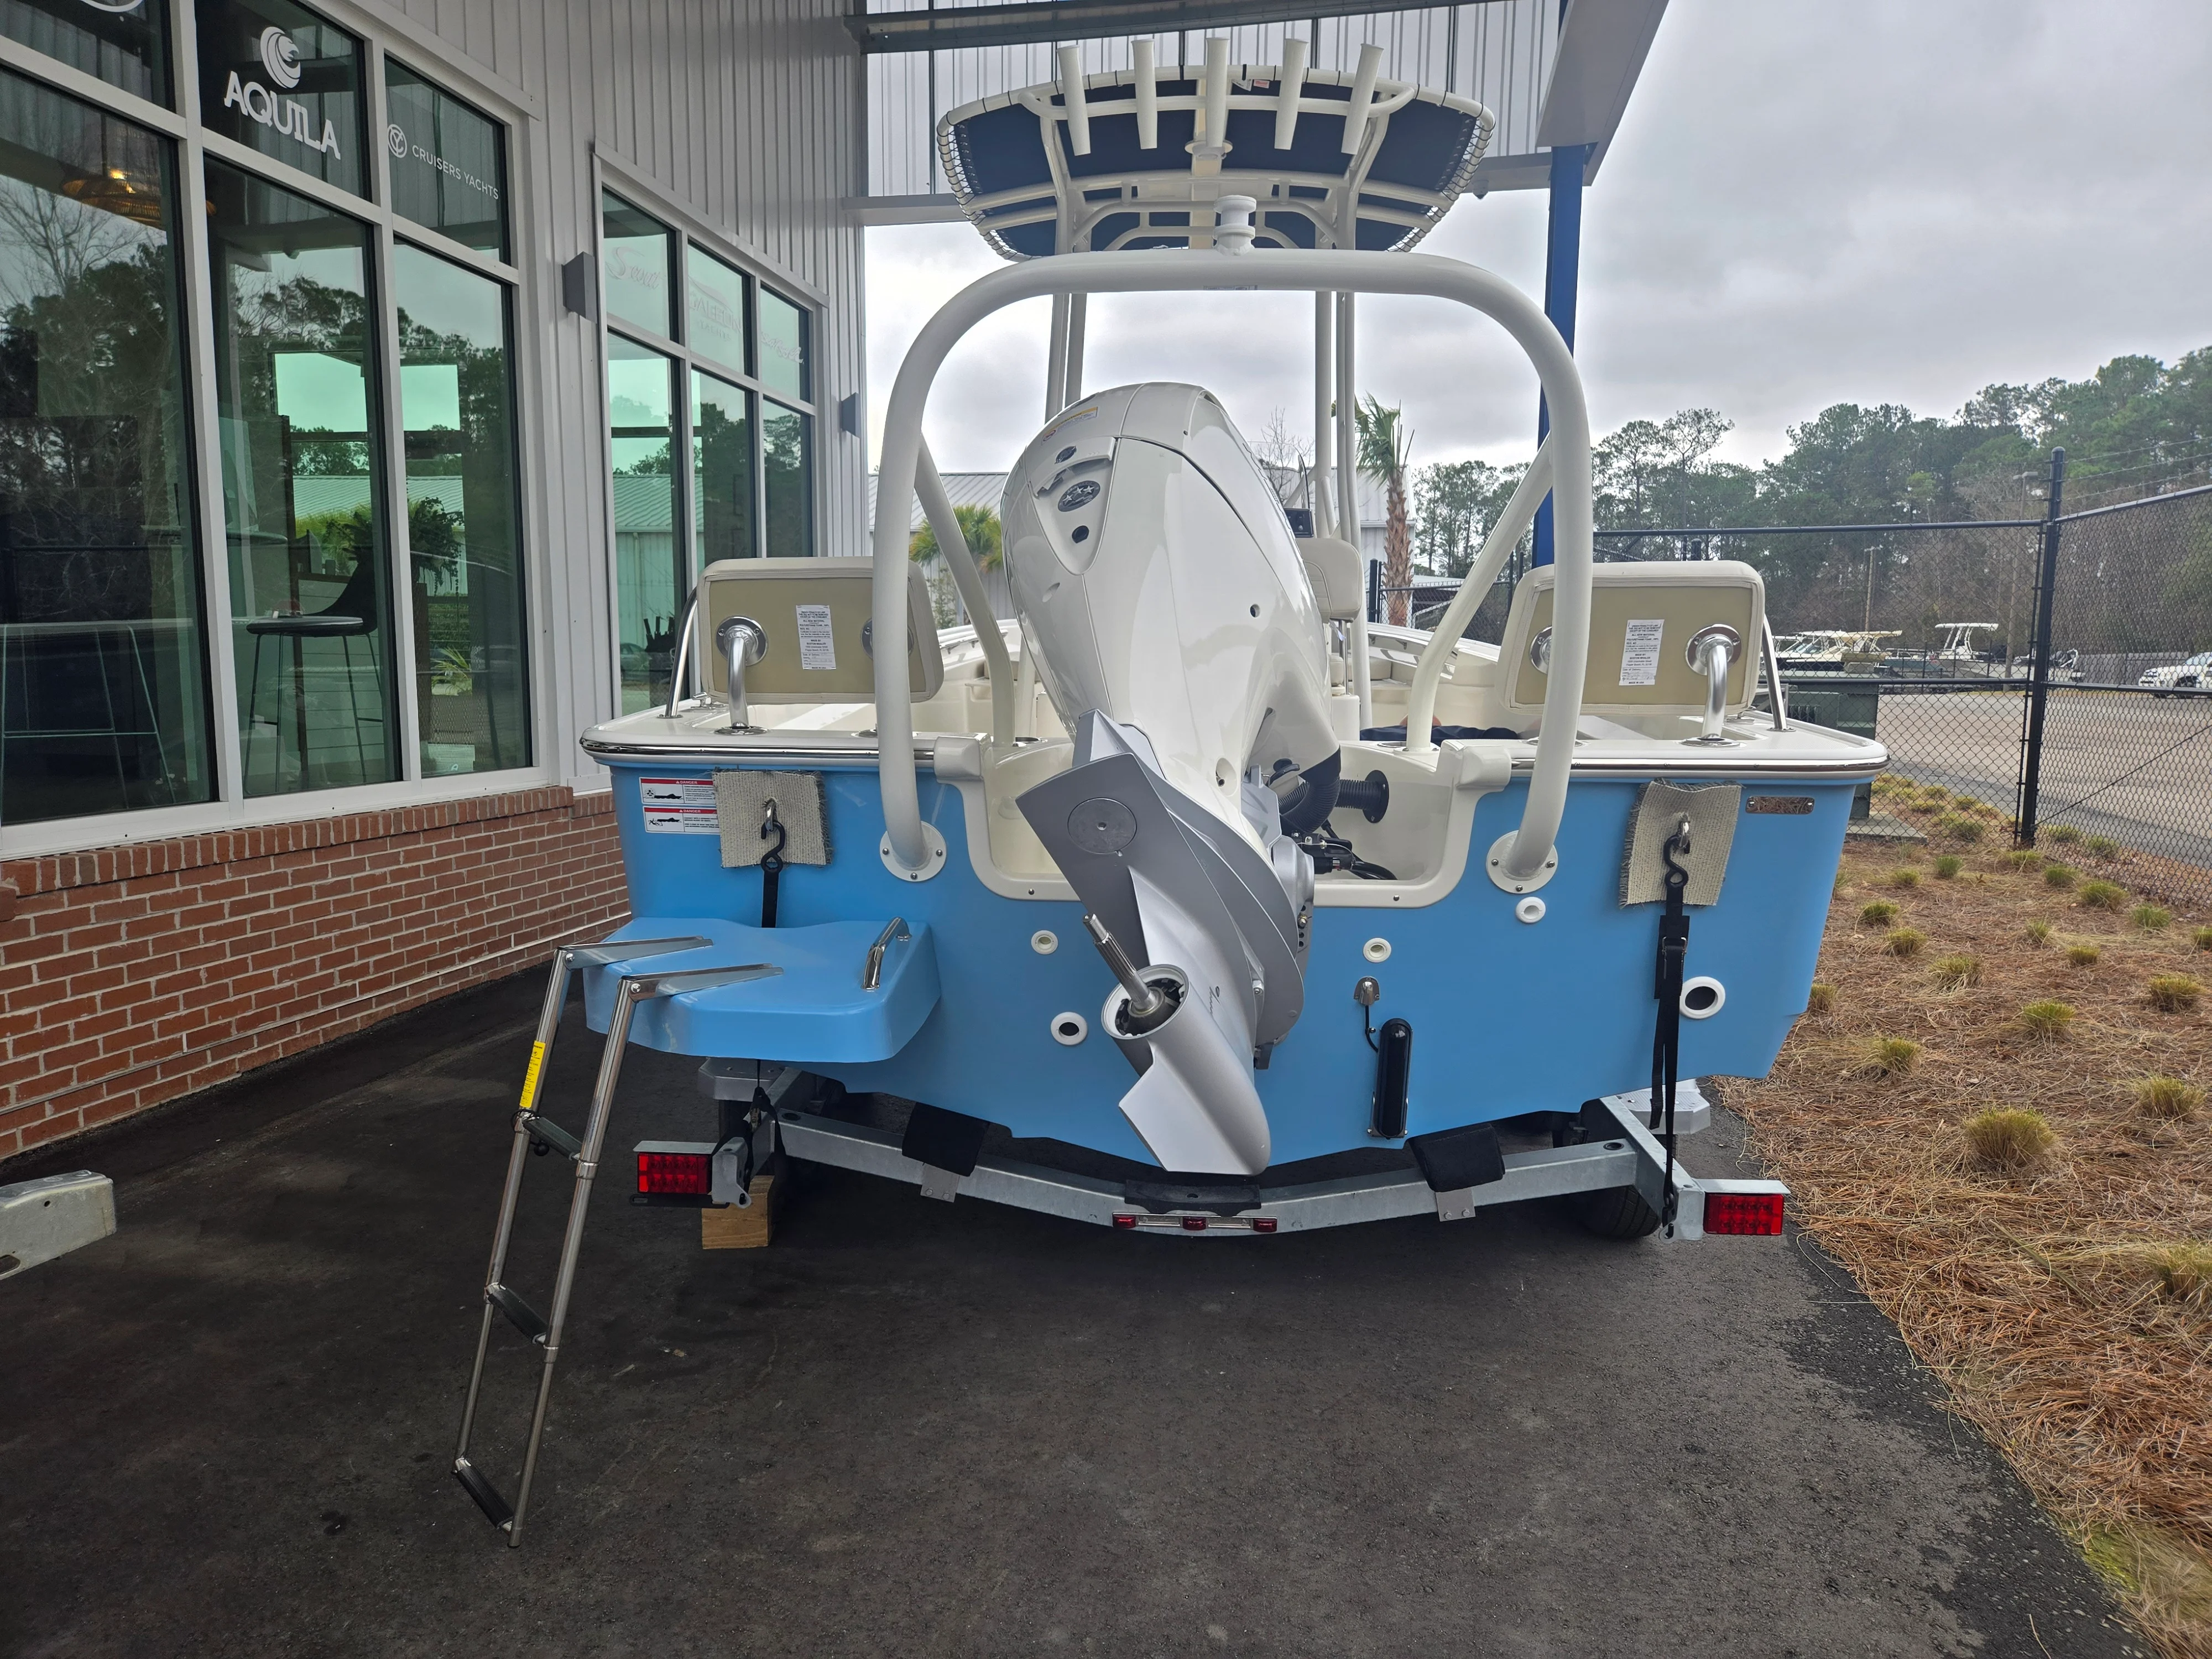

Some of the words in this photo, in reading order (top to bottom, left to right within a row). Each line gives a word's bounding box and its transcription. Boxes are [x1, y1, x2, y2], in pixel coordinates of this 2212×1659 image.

[225, 71, 341, 160] AQUILA
[412, 145, 461, 180] CRUISERS
[463, 171, 499, 200] YACHTS
[605, 247, 661, 290] Scout
